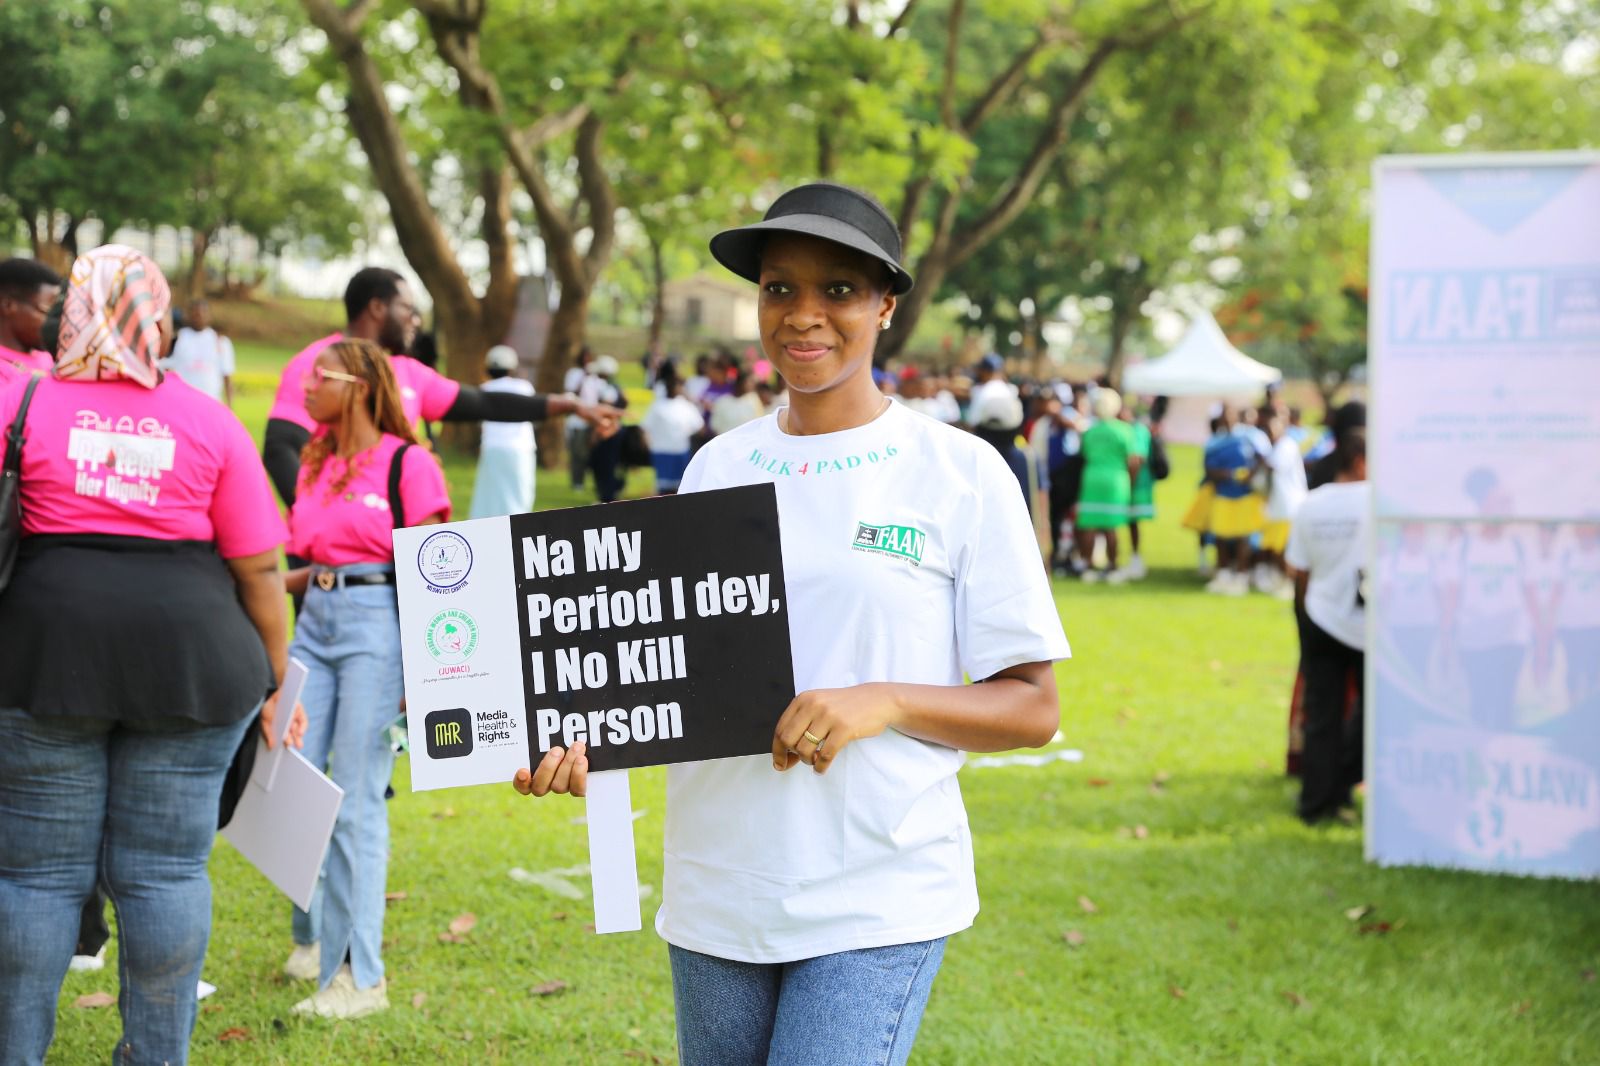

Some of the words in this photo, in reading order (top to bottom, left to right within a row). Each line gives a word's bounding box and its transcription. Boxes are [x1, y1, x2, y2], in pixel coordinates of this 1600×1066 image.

[115, 415, 134, 433] A
[798, 462, 809, 475] 4
[816, 455, 861, 474] PAD
[867, 443, 898, 463] 0.6
[75, 471, 104, 497] Her
[106, 475, 160, 507] Dignity
[522, 535, 576, 580] Na
[584, 527, 641, 573] My
[876, 526, 925, 560] FAAN
[527, 580, 663, 637] Period
[671, 577, 686, 620] I
[695, 572, 780, 618] dey,
[438, 665, 470, 676] (JUWACI)
[532, 651, 547, 695] I
[555, 647, 608, 692] No
[617, 635, 686, 685] Kill
[477, 710, 508, 721] Media
[477, 720, 508, 731] Health
[510, 718, 517, 729] &
[536, 702, 683, 753] Person
[435, 722, 463, 747] MHR
[478, 731, 510, 743] Rights
